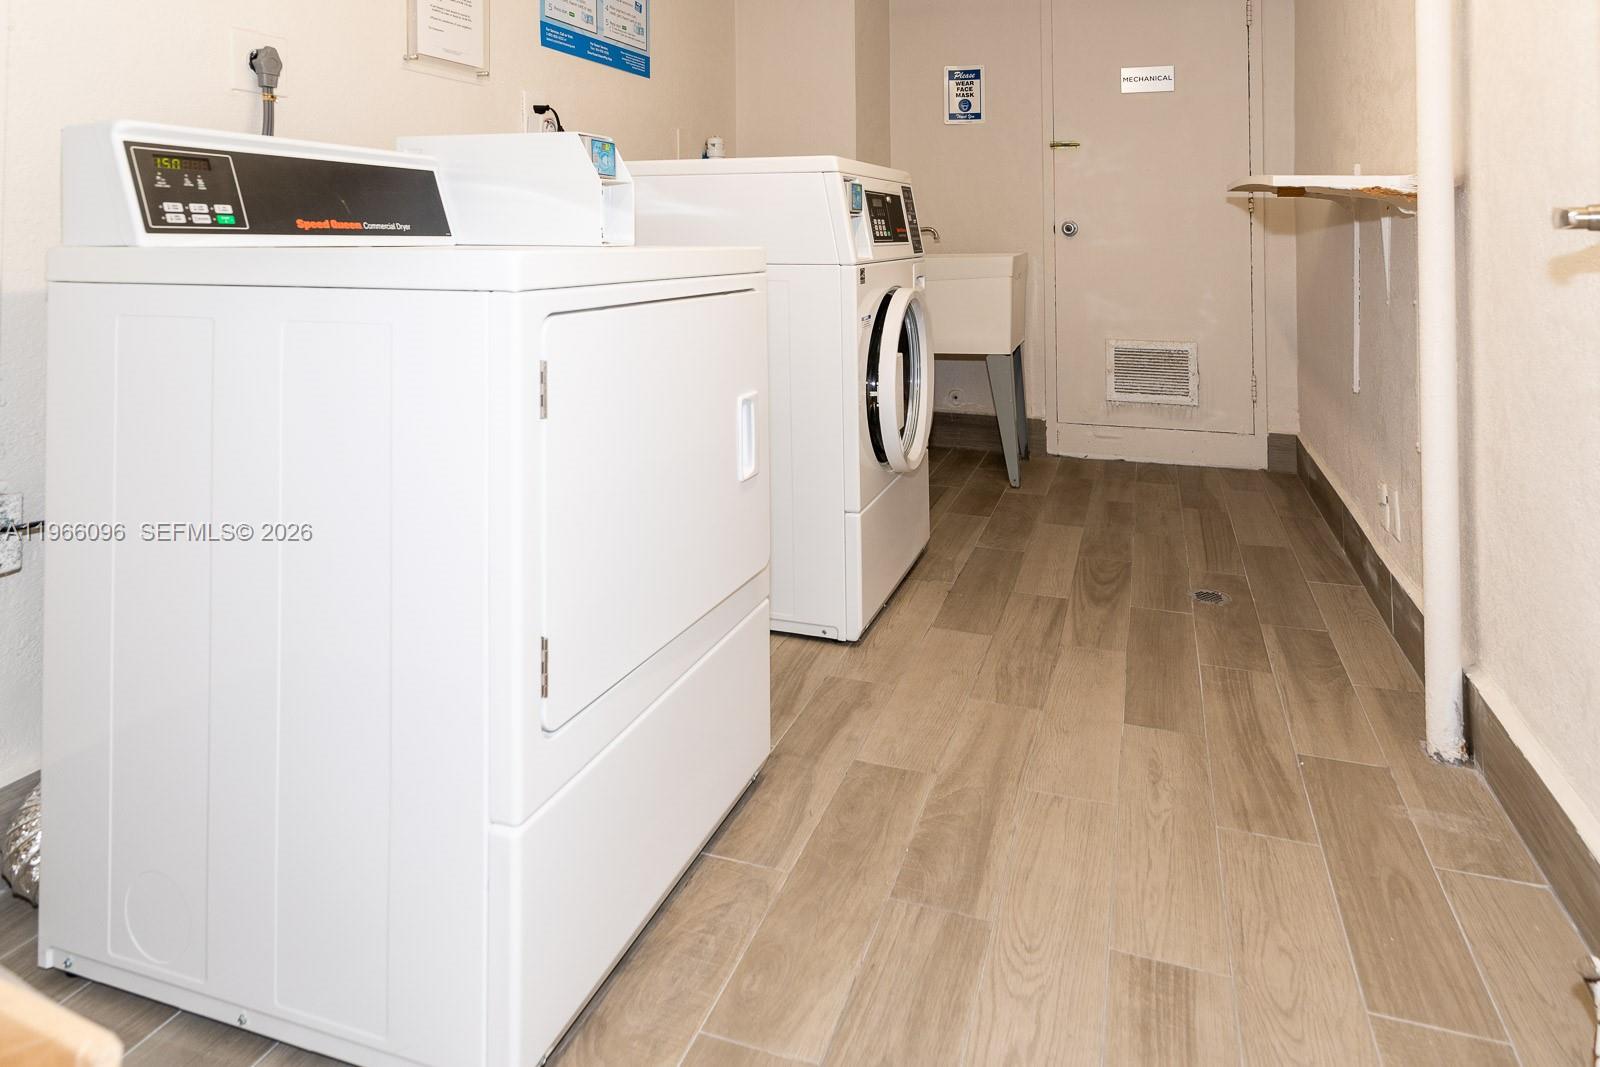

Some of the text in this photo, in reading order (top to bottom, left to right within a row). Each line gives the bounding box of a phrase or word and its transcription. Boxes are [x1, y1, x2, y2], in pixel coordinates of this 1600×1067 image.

[954, 71, 976, 79] Please
[1122, 75, 1173, 83] MECHANICAL
[296, 218, 411, 232] Speed Queen Commercial Dryer
